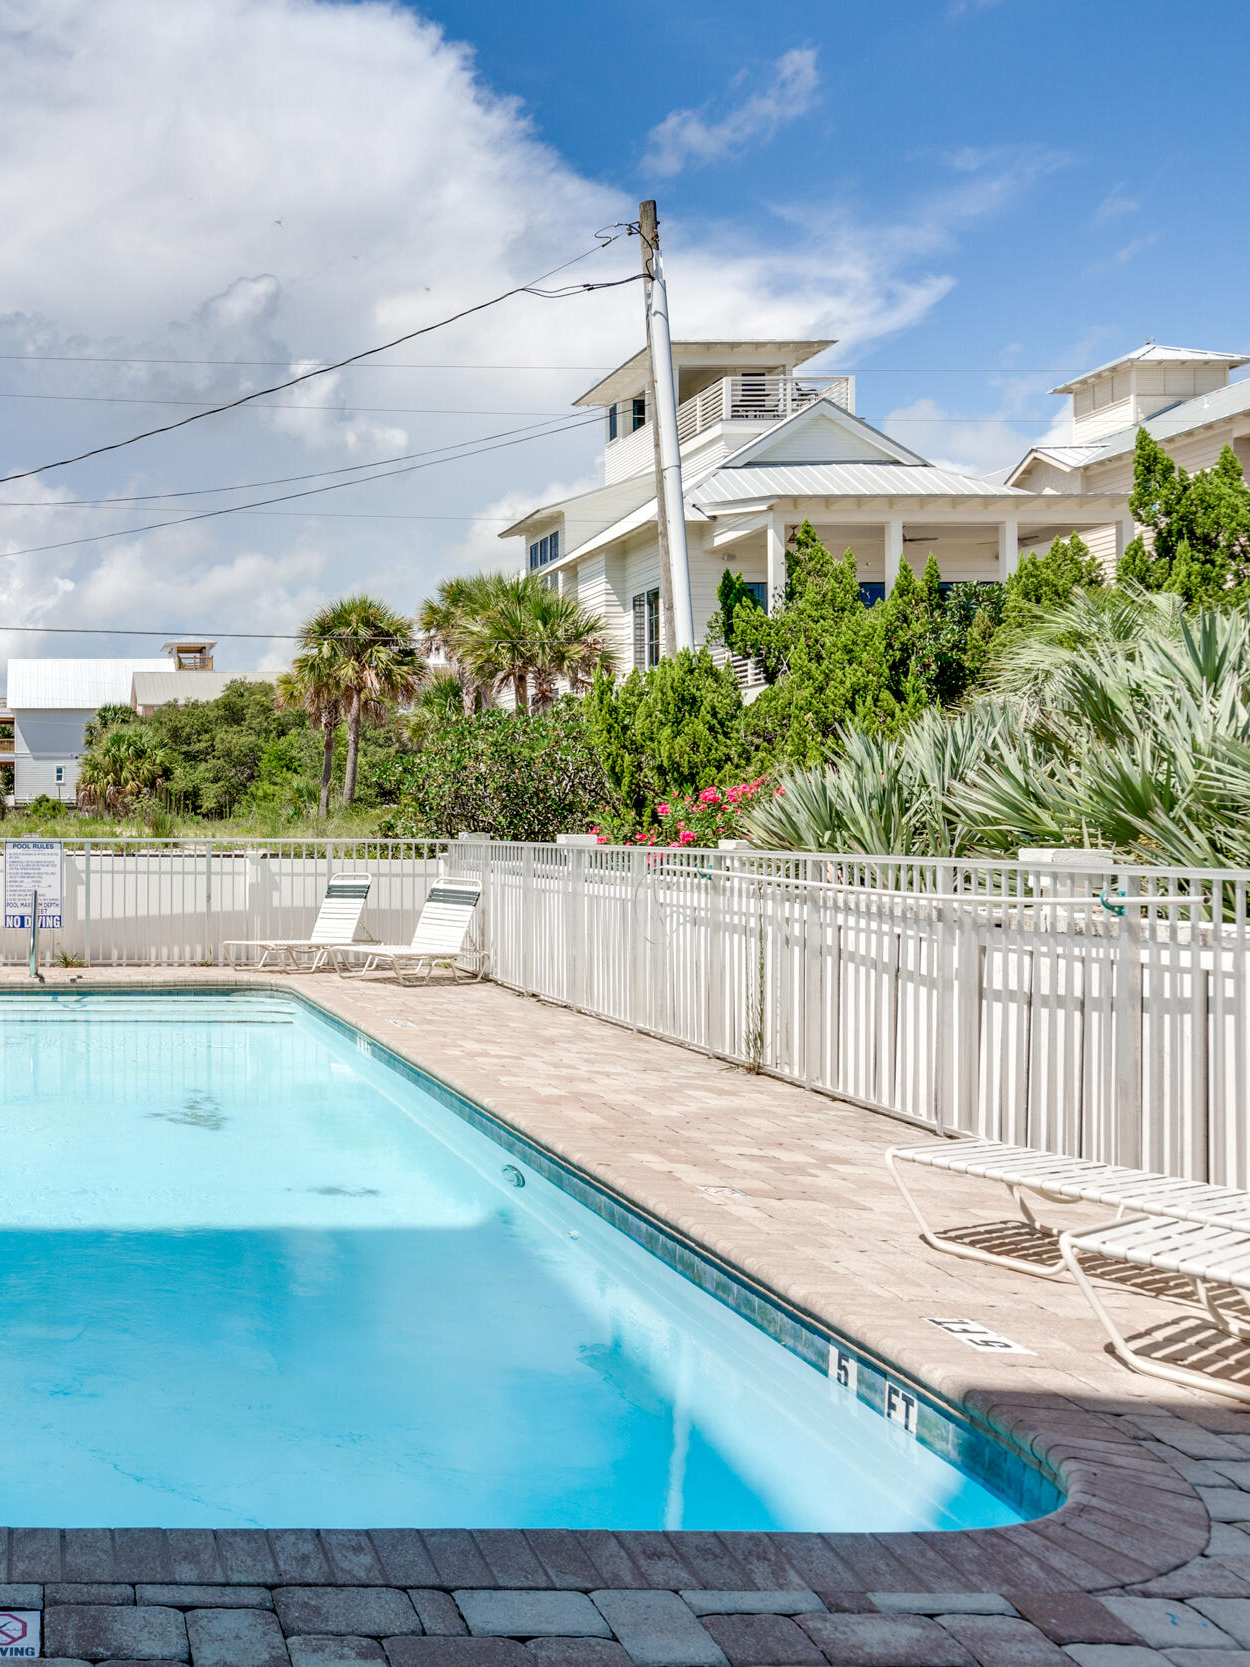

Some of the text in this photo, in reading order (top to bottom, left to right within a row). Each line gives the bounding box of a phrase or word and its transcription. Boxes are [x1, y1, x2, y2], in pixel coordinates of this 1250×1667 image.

[6, 915, 21, 928] NO
[966, 1338, 1013, 1349] 5
[837, 1351, 849, 1387] 5
